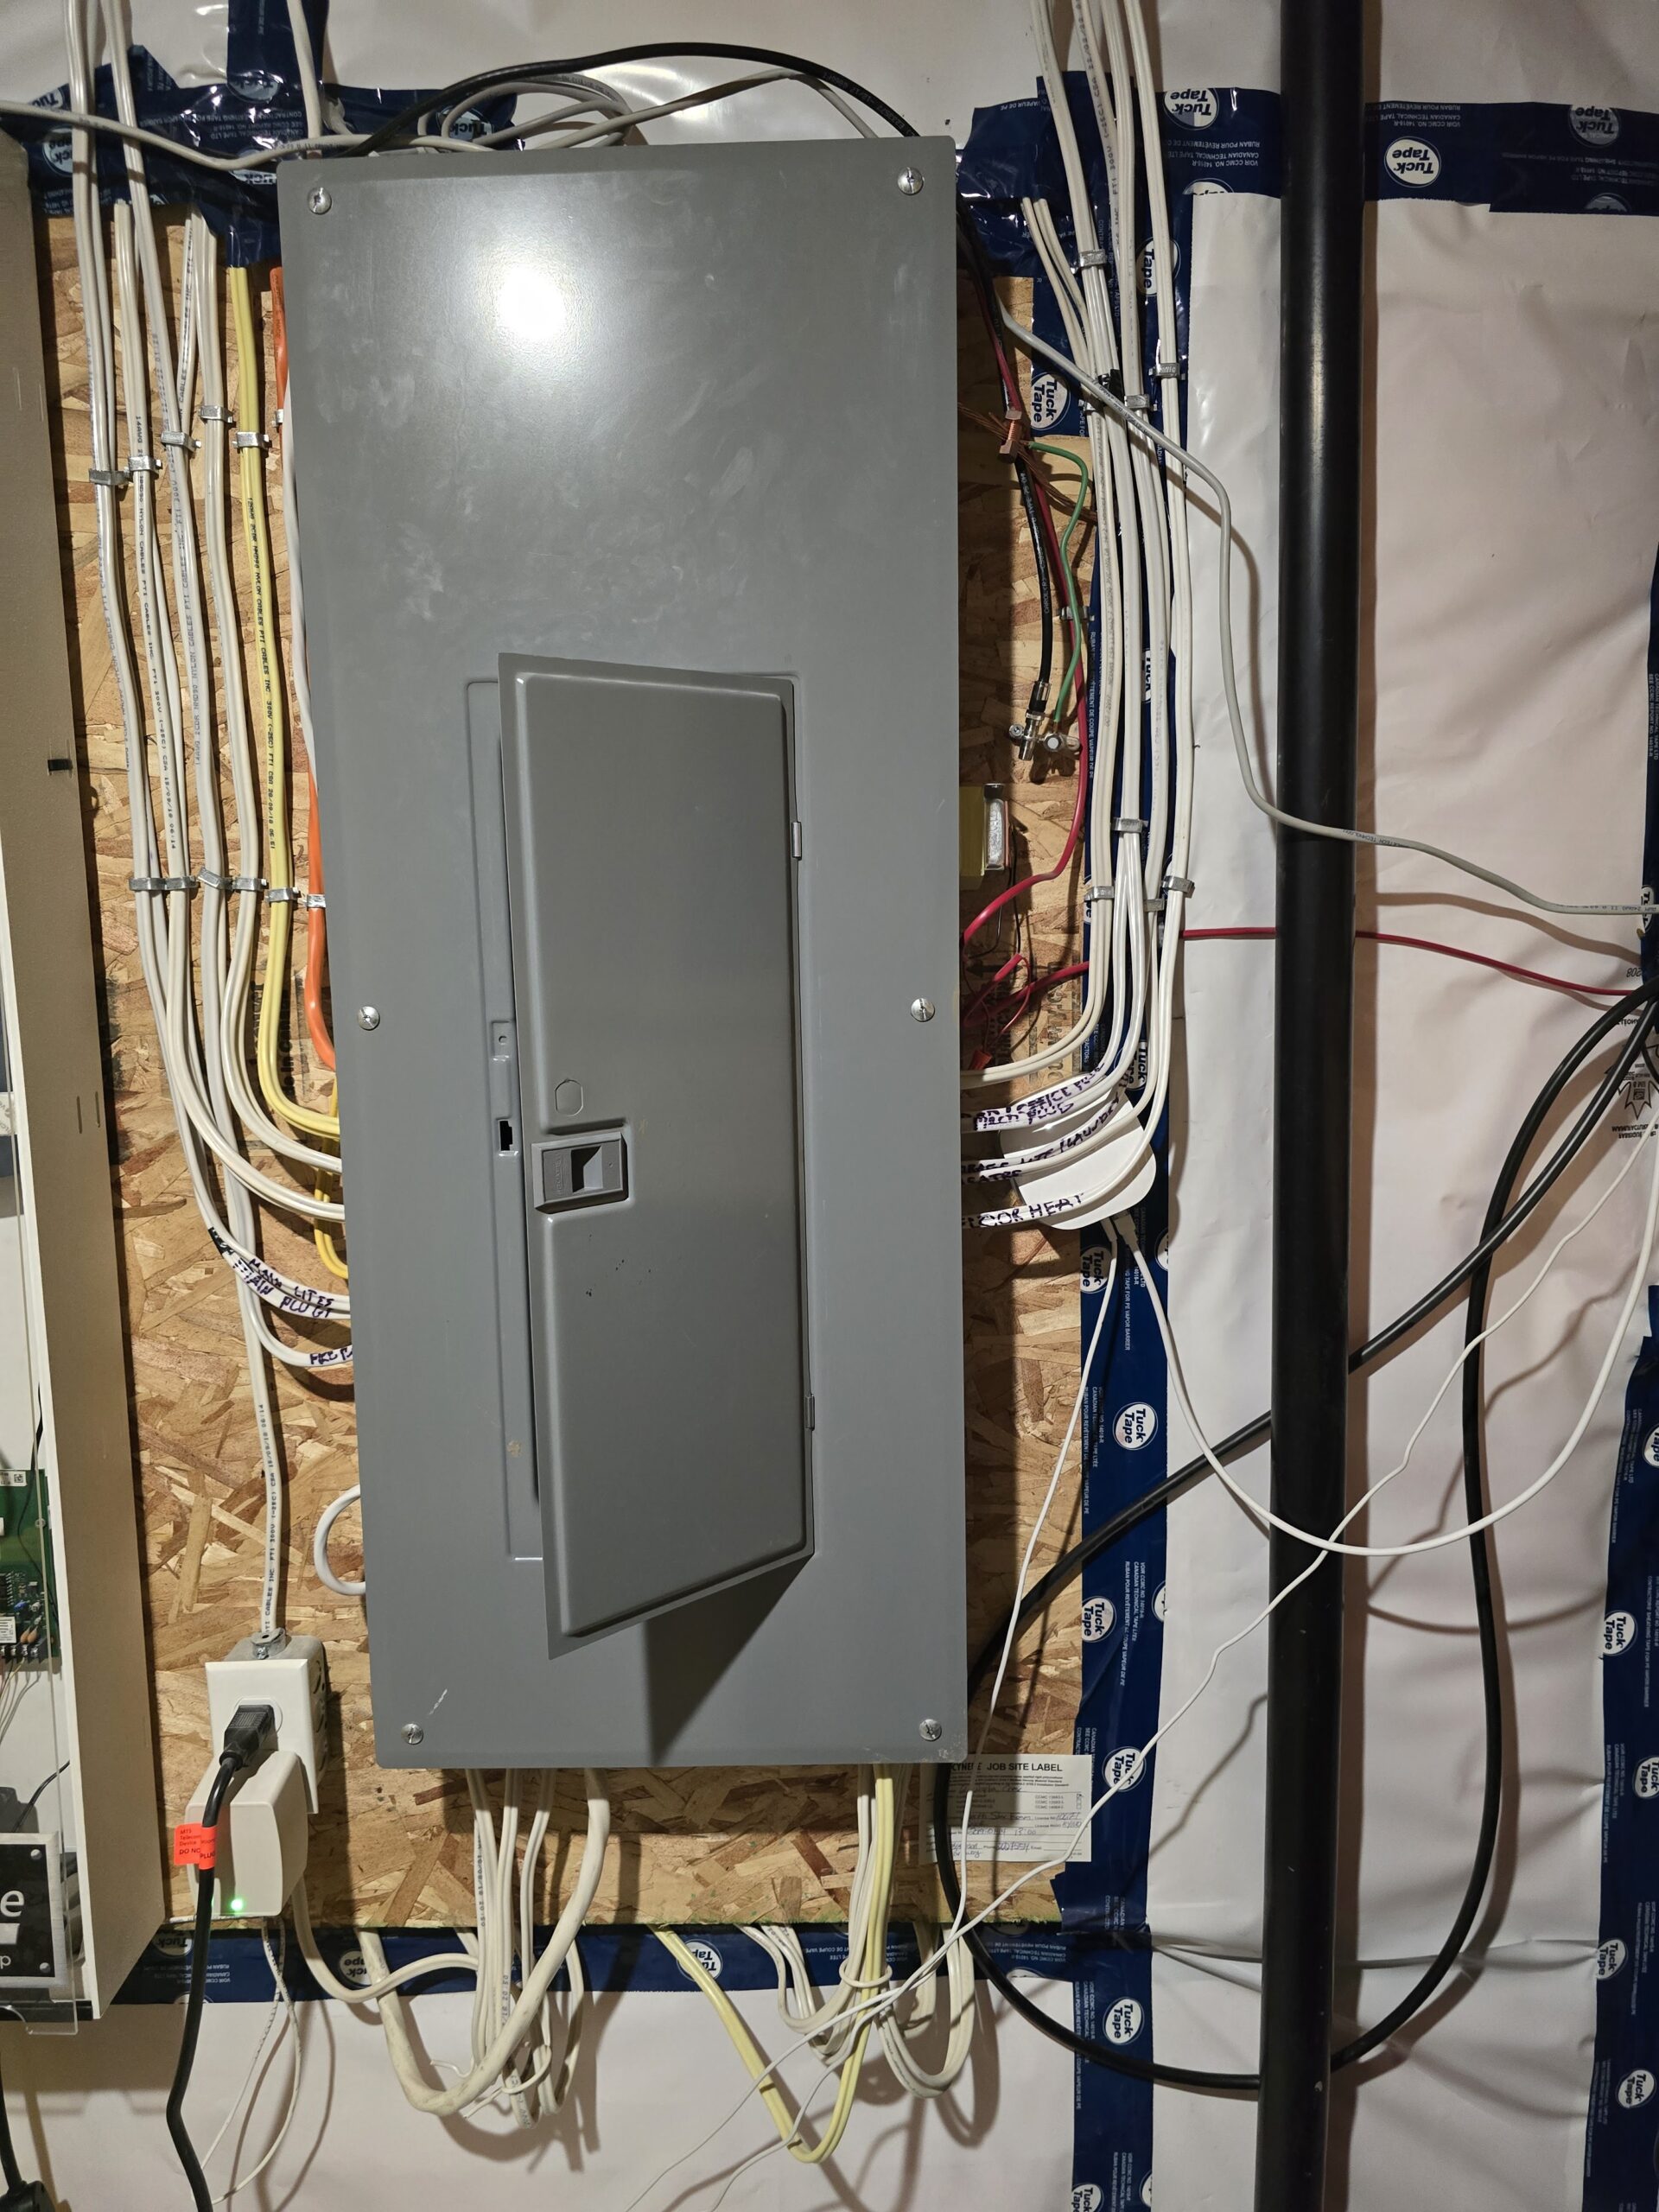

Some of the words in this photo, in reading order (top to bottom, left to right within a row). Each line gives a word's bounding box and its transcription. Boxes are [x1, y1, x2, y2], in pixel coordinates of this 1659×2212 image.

[1170, 89, 1208, 102] Tape
[1174, 104, 1211, 116] Tuck
[1575, 106, 1611, 120] Tape
[1578, 122, 1614, 134] Tuck
[1392, 147, 1429, 161] Tape
[1396, 162, 1433, 174] Tuck
[1143, 249, 1154, 289] Tape
[1032, 385, 1046, 423] Tape
[1046, 380, 1058, 417] Tuck
[186, 615, 194, 647] CABLES
[1028, 1192, 1084, 1217] HEAT
[1081, 1255, 1092, 1287] Tape
[1094, 1251, 1103, 1284] Tuck
[1123, 1413, 1134, 1443] Tape
[1135, 1408, 1146, 1440] Tuck
[264, 1586, 273, 1616] CABLES
[1082, 1605, 1093, 1637] Tape
[1095, 1602, 1104, 1633] Tuck
[1616, 1617, 1625, 1646] Tuck
[1604, 1620, 1614, 1650] Tape
[1641, 1764, 1649, 1793] Tape
[1597, 1948, 1609, 1975] Tape
[1608, 1942, 1618, 1971] Tuck
[1113, 2007, 1122, 2038] Tape
[1124, 2005, 1133, 2035] Tuck
[1625, 2078, 1635, 2105] Tape
[1635, 2073, 1646, 2101] Tuck
[1084, 2188, 1093, 2212] Tuck
